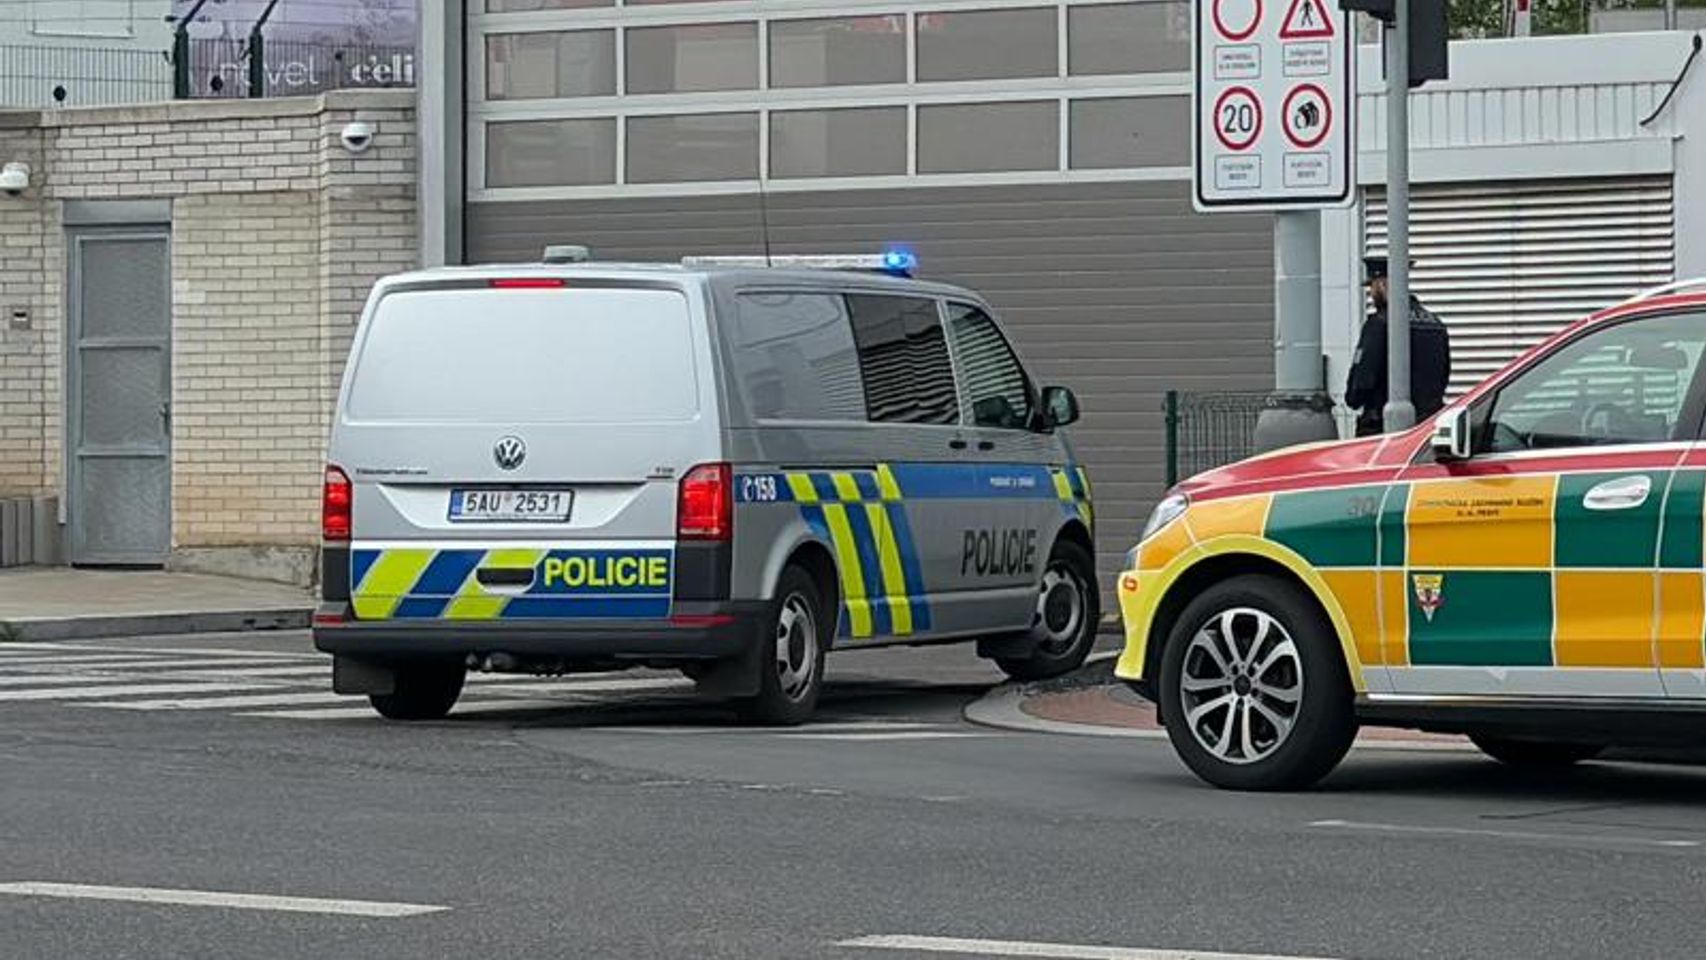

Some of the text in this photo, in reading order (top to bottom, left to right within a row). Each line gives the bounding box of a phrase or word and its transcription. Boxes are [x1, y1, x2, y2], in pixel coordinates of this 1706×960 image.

[1223, 104, 1253, 133] 20
[467, 493, 560, 512] 5AU 2531
[754, 476, 776, 501] 158
[962, 529, 1037, 576] POLICIE
[544, 556, 667, 587] POLICIE
